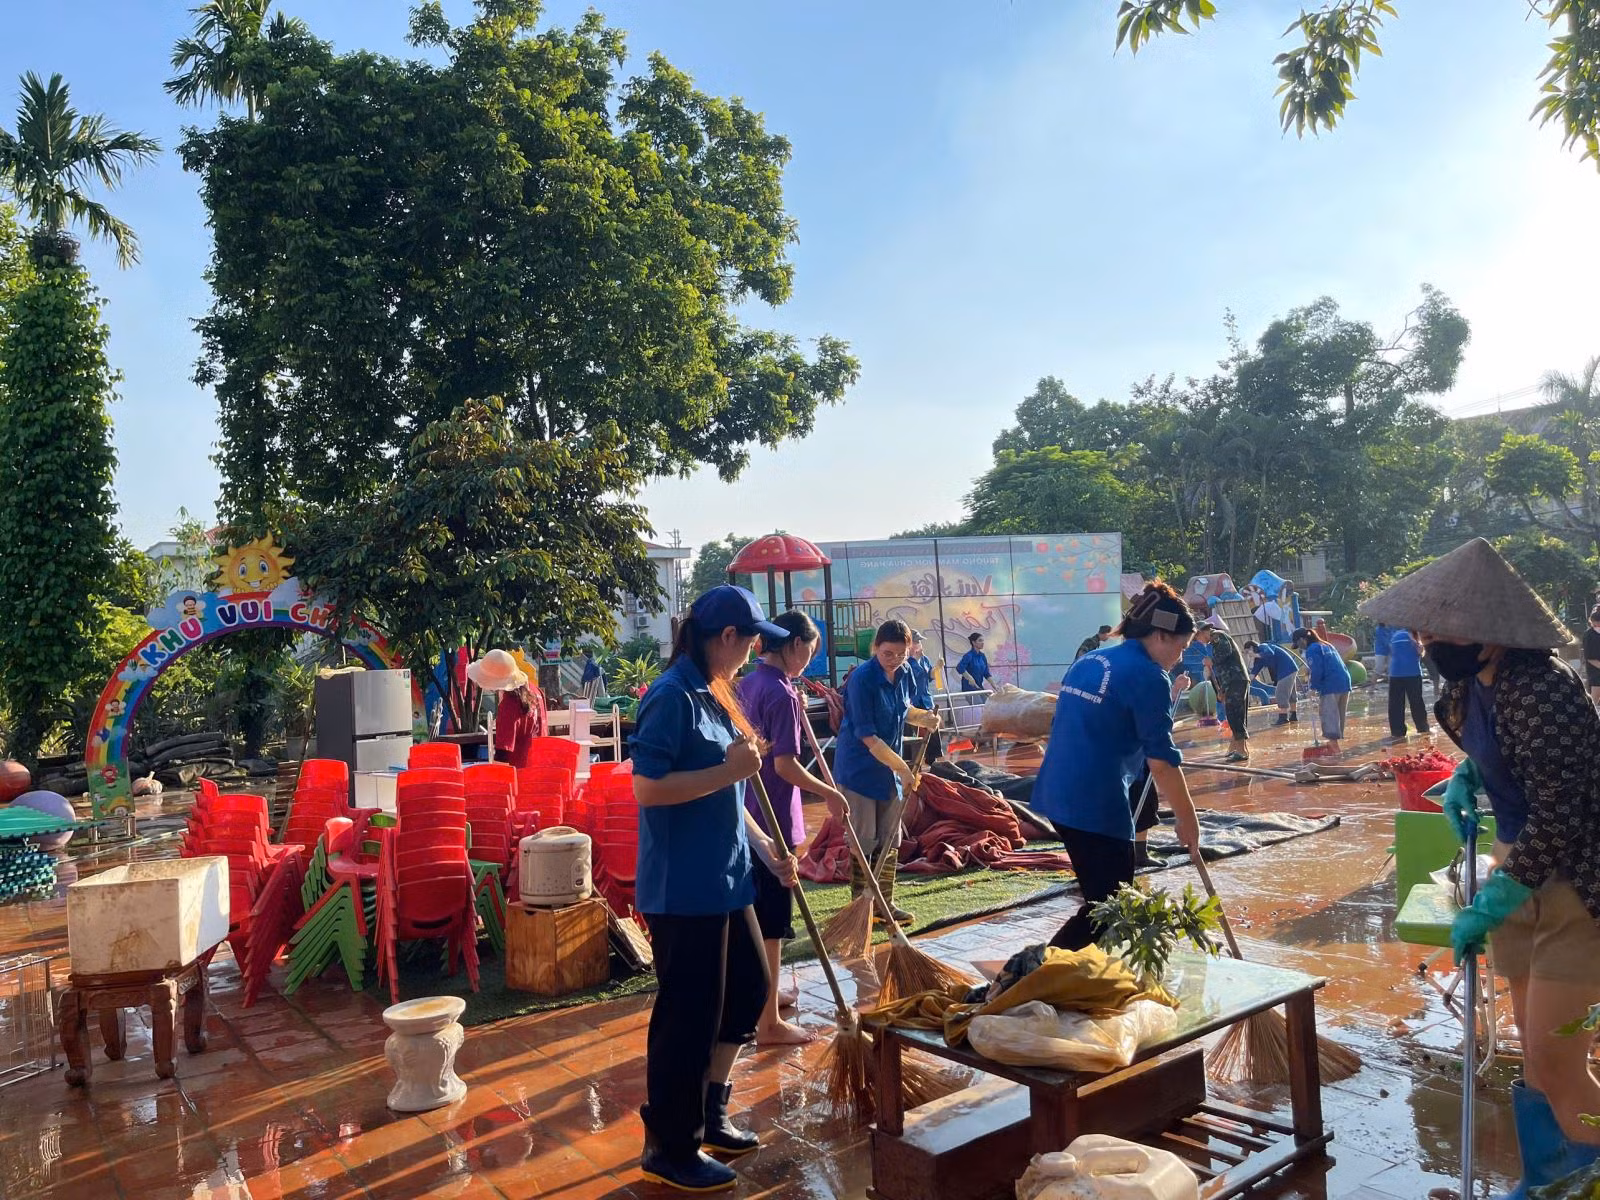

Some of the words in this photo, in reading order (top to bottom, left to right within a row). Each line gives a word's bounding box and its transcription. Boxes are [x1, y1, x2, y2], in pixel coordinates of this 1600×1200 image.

[138, 617, 204, 668] KHU
[216, 599, 274, 627] VUI
[289, 602, 341, 635] CH
